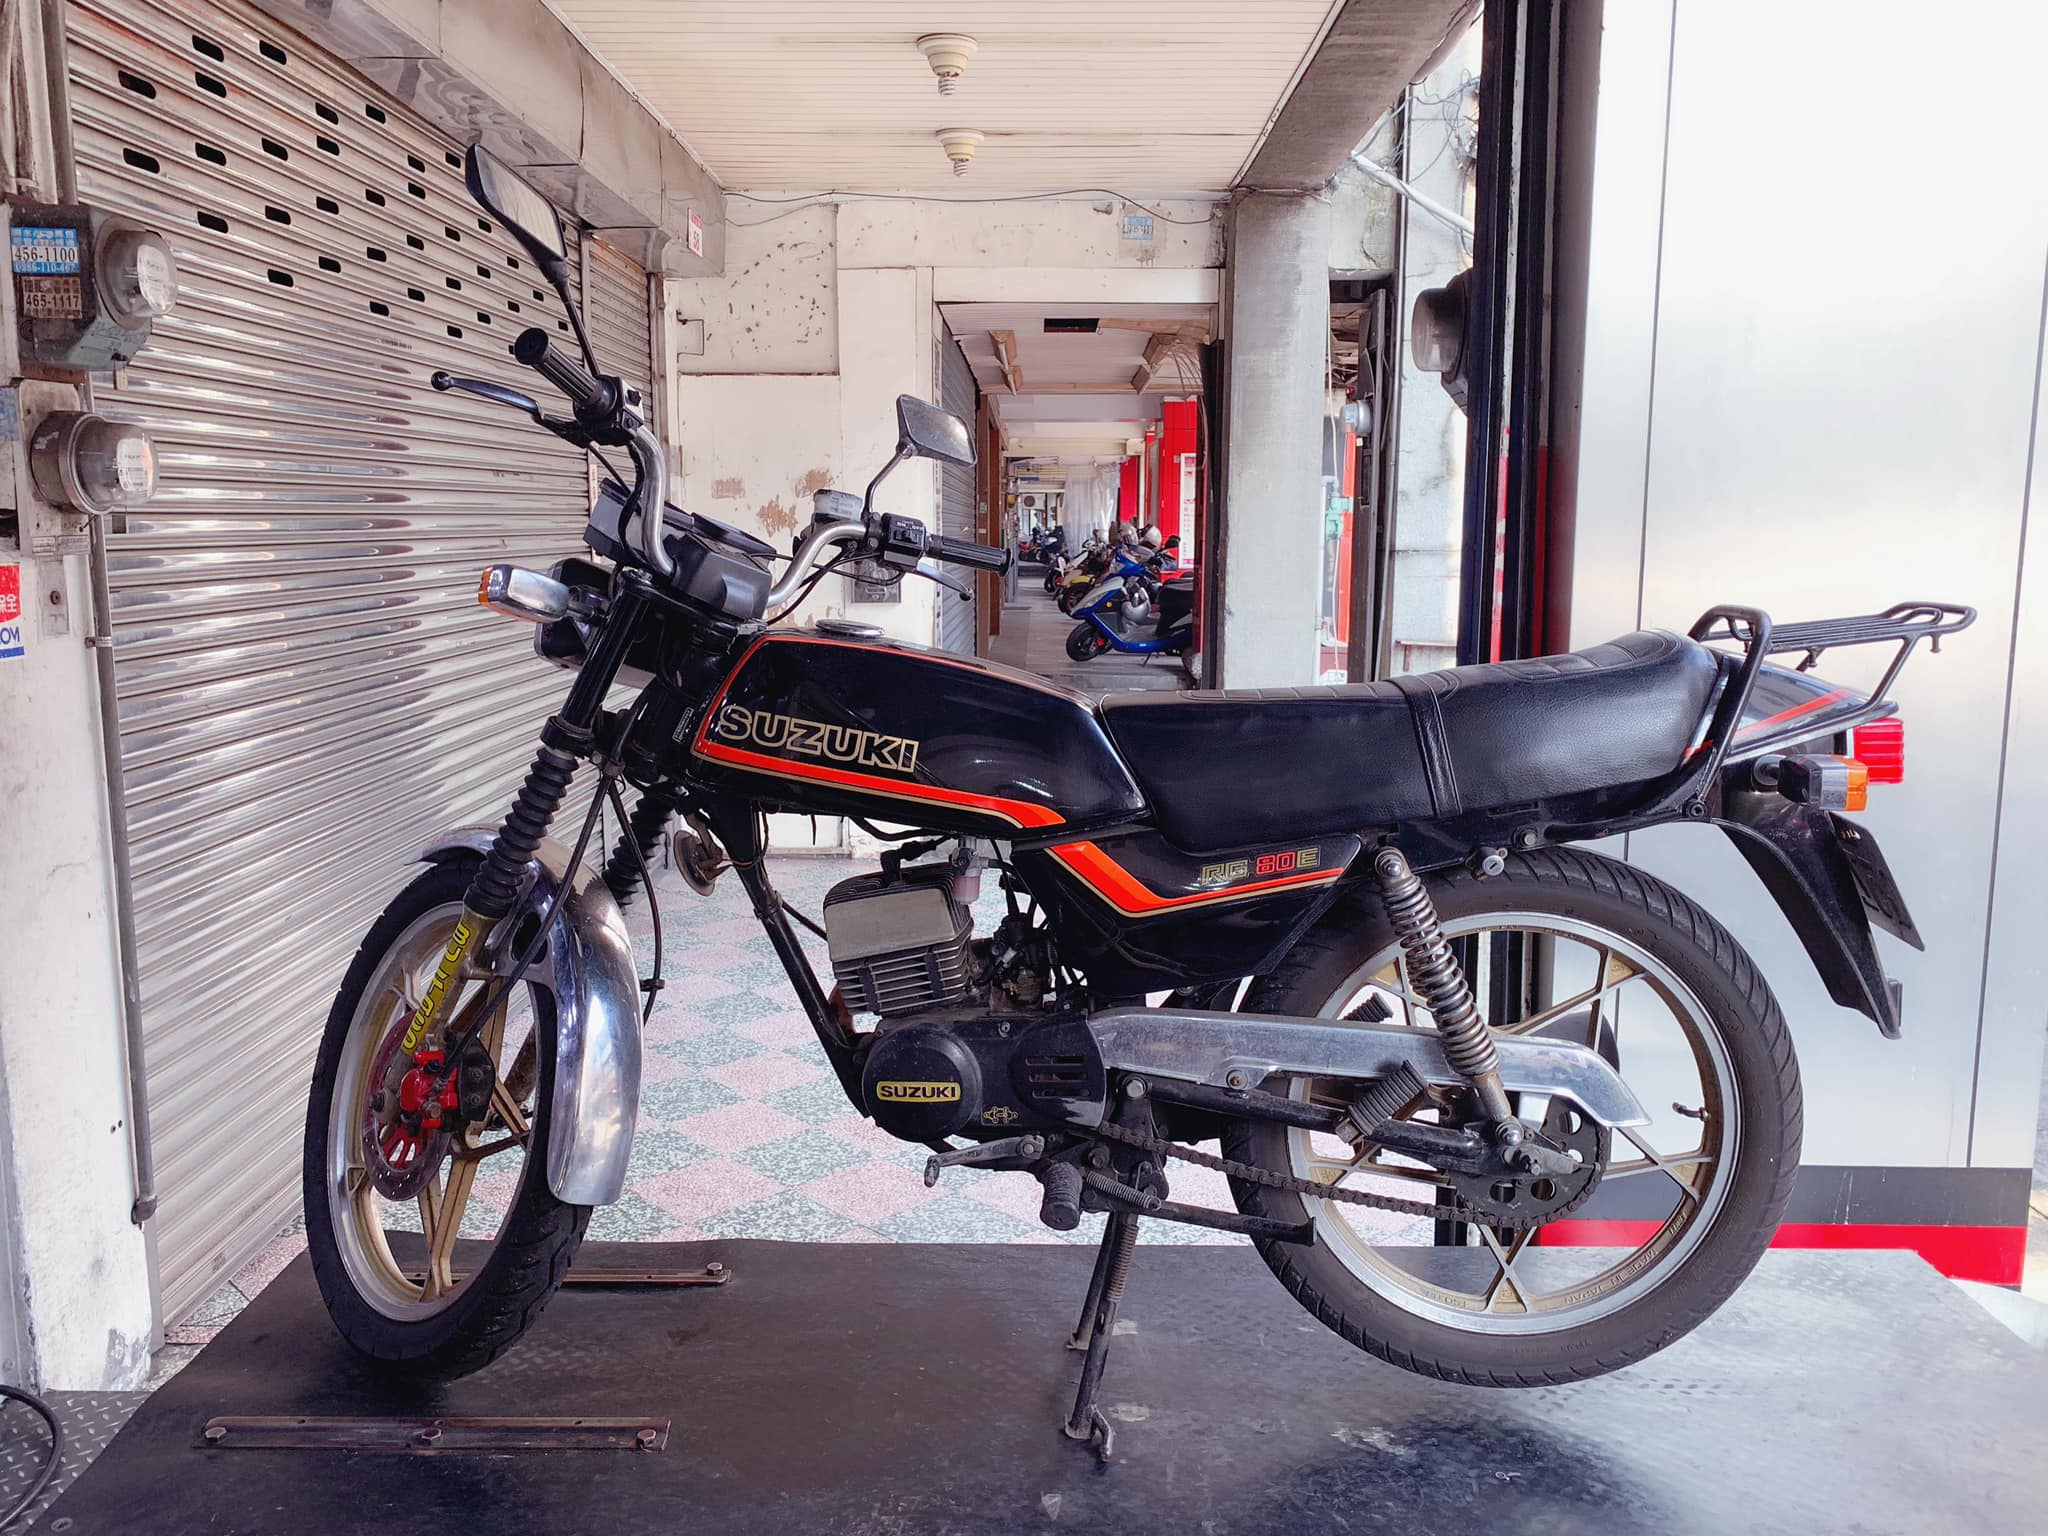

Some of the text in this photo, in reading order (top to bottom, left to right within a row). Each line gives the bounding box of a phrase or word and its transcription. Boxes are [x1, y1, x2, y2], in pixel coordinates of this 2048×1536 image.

[14, 246, 76, 262] 456-1100
[26, 294, 79, 308] 465-1117
[0, 626, 20, 645] OM
[718, 705, 920, 773] SUZUKI
[1201, 859, 1249, 885] RG
[881, 1085, 956, 1098] SUZUKI
